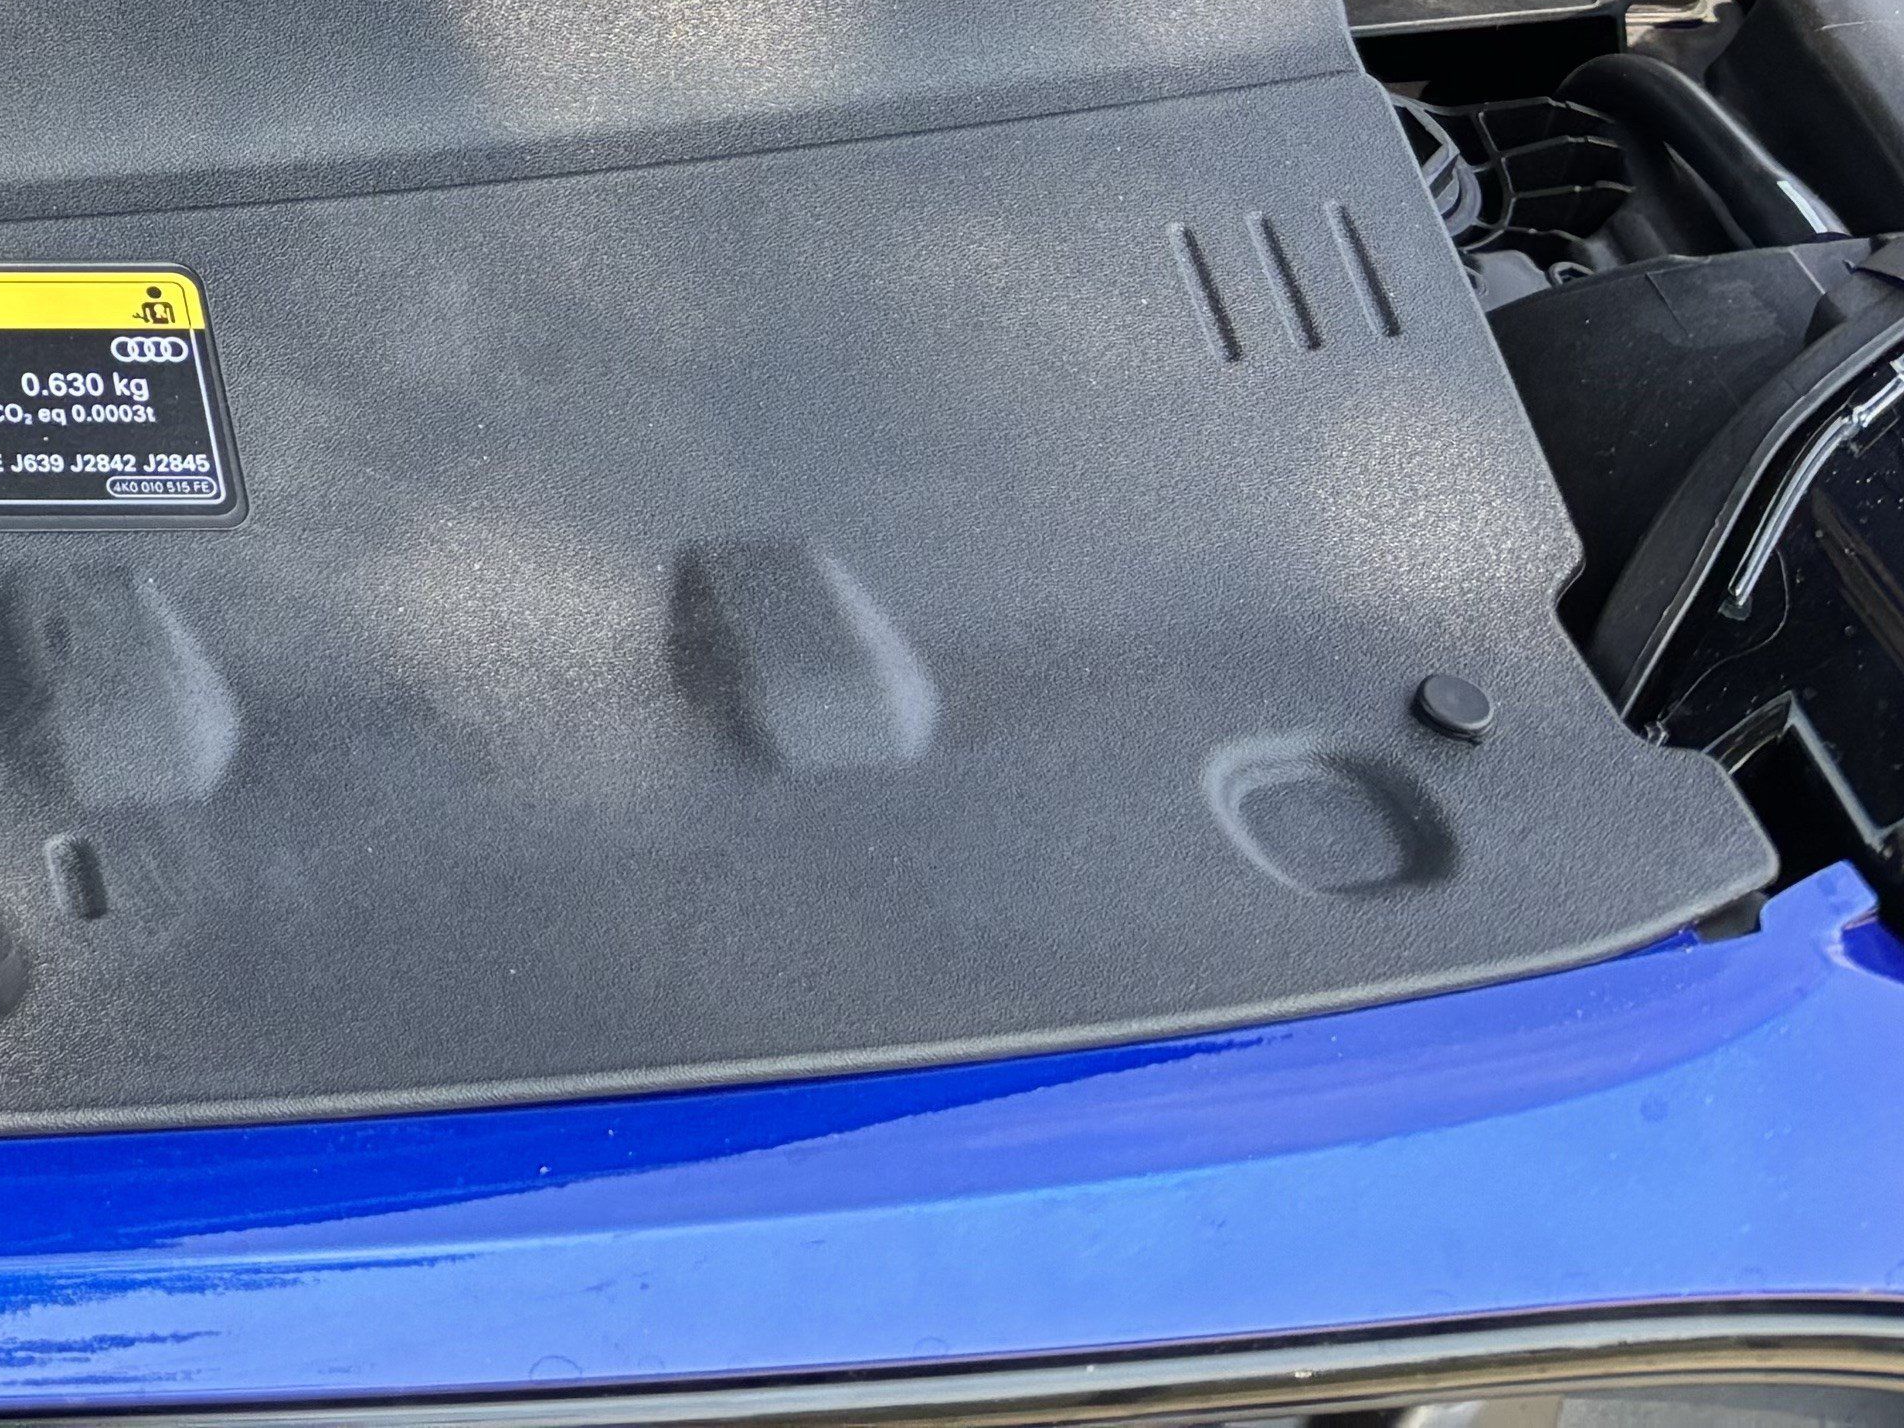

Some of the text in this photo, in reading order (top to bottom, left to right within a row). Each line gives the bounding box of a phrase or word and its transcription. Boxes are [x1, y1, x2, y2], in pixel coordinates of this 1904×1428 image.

[20, 370, 150, 401] 0.630 kg
[36, 407, 67, 426] eq
[70, 403, 156, 423] 0.0003t
[9, 452, 65, 473] J639
[69, 452, 137, 473] J2842
[141, 452, 211, 473] J2845
[139, 480, 164, 493] 010
